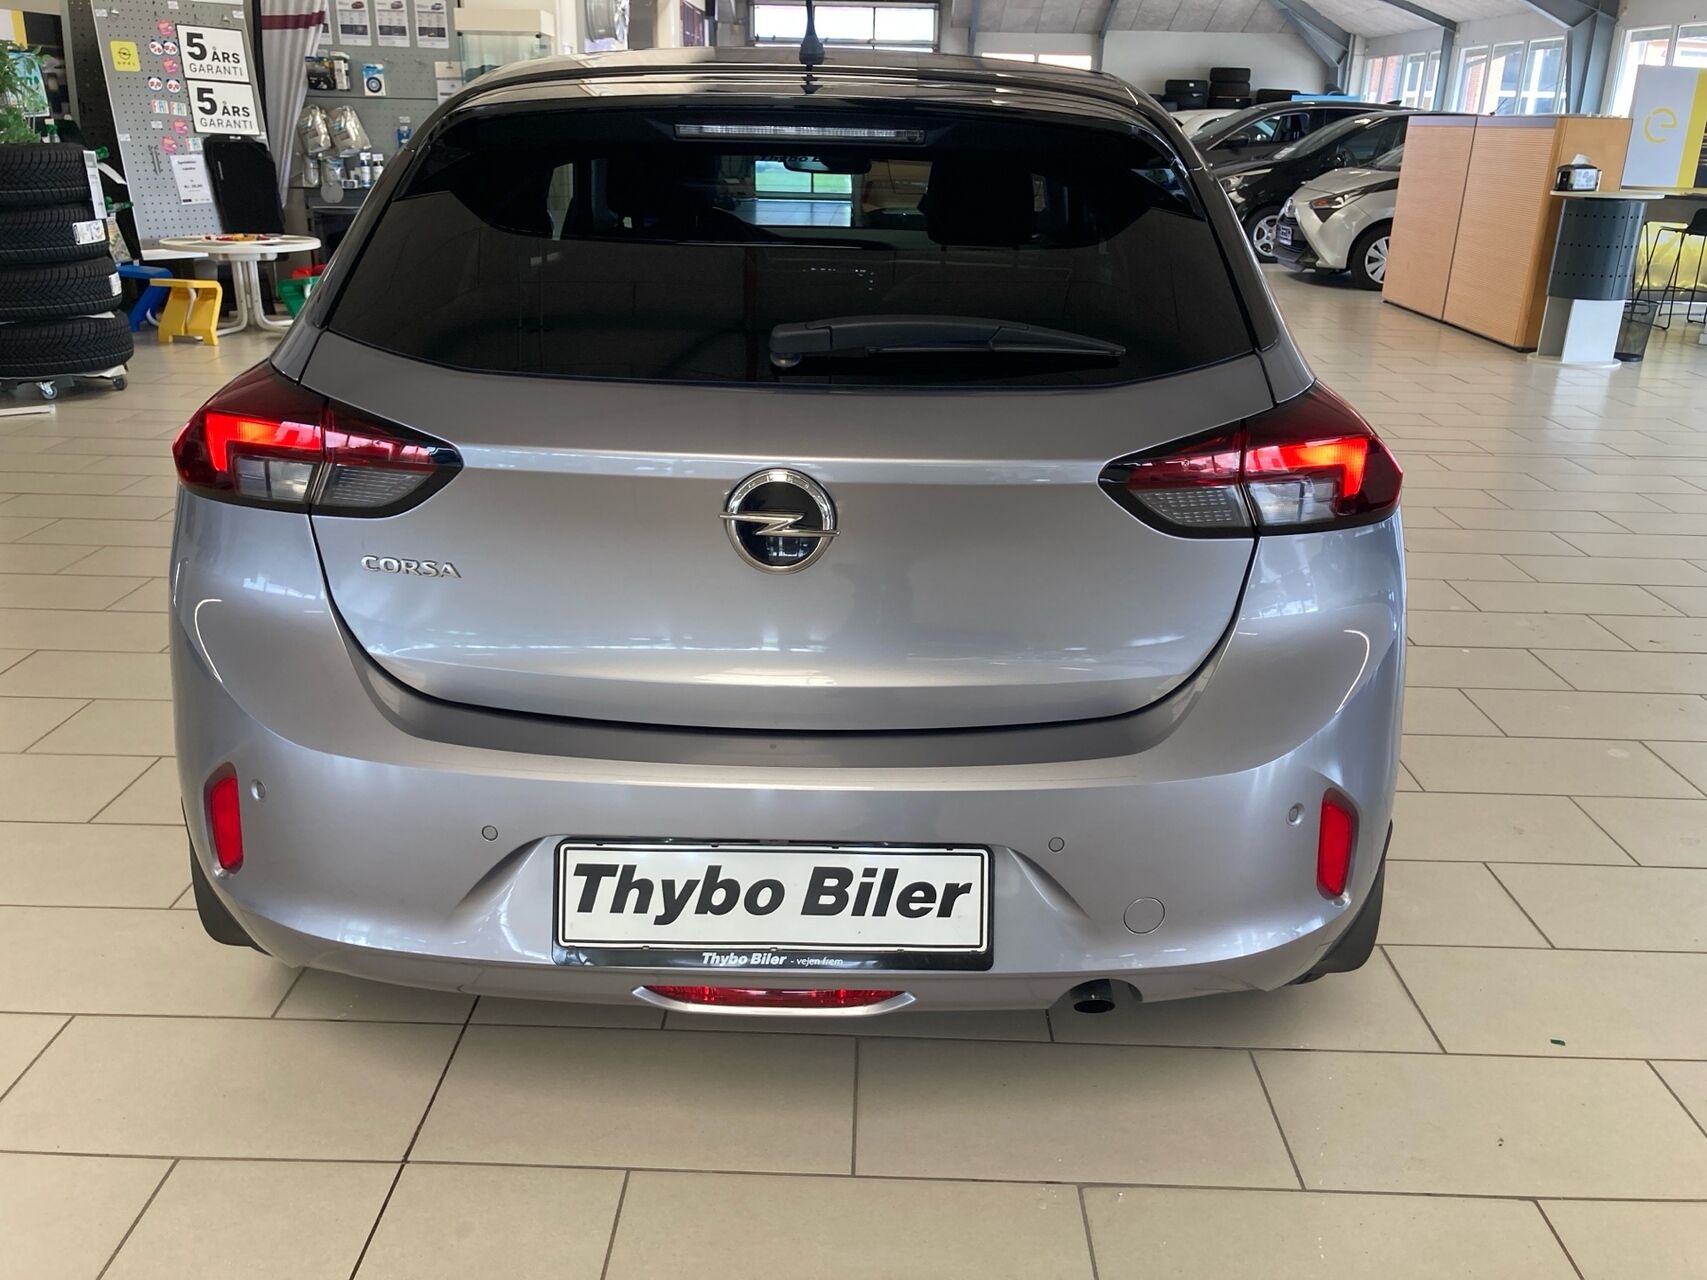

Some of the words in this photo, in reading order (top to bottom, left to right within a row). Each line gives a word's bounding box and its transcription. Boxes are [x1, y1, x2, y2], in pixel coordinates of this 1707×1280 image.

[186, 32, 207, 61] 5
[211, 46, 240, 64] ÅRS
[189, 62, 243, 76] GARANTI
[197, 87, 218, 116] 5
[221, 101, 250, 117] ÅRS
[200, 118, 253, 130] GARANTI
[361, 555, 462, 578] CORSA
[573, 863, 786, 925] Thybo
[800, 866, 973, 918] Biler
[702, 952, 748, 966] Thybo
[750, 953, 787, 965] Biler
[796, 957, 820, 967] vejen
[821, 956, 844, 966] frem
